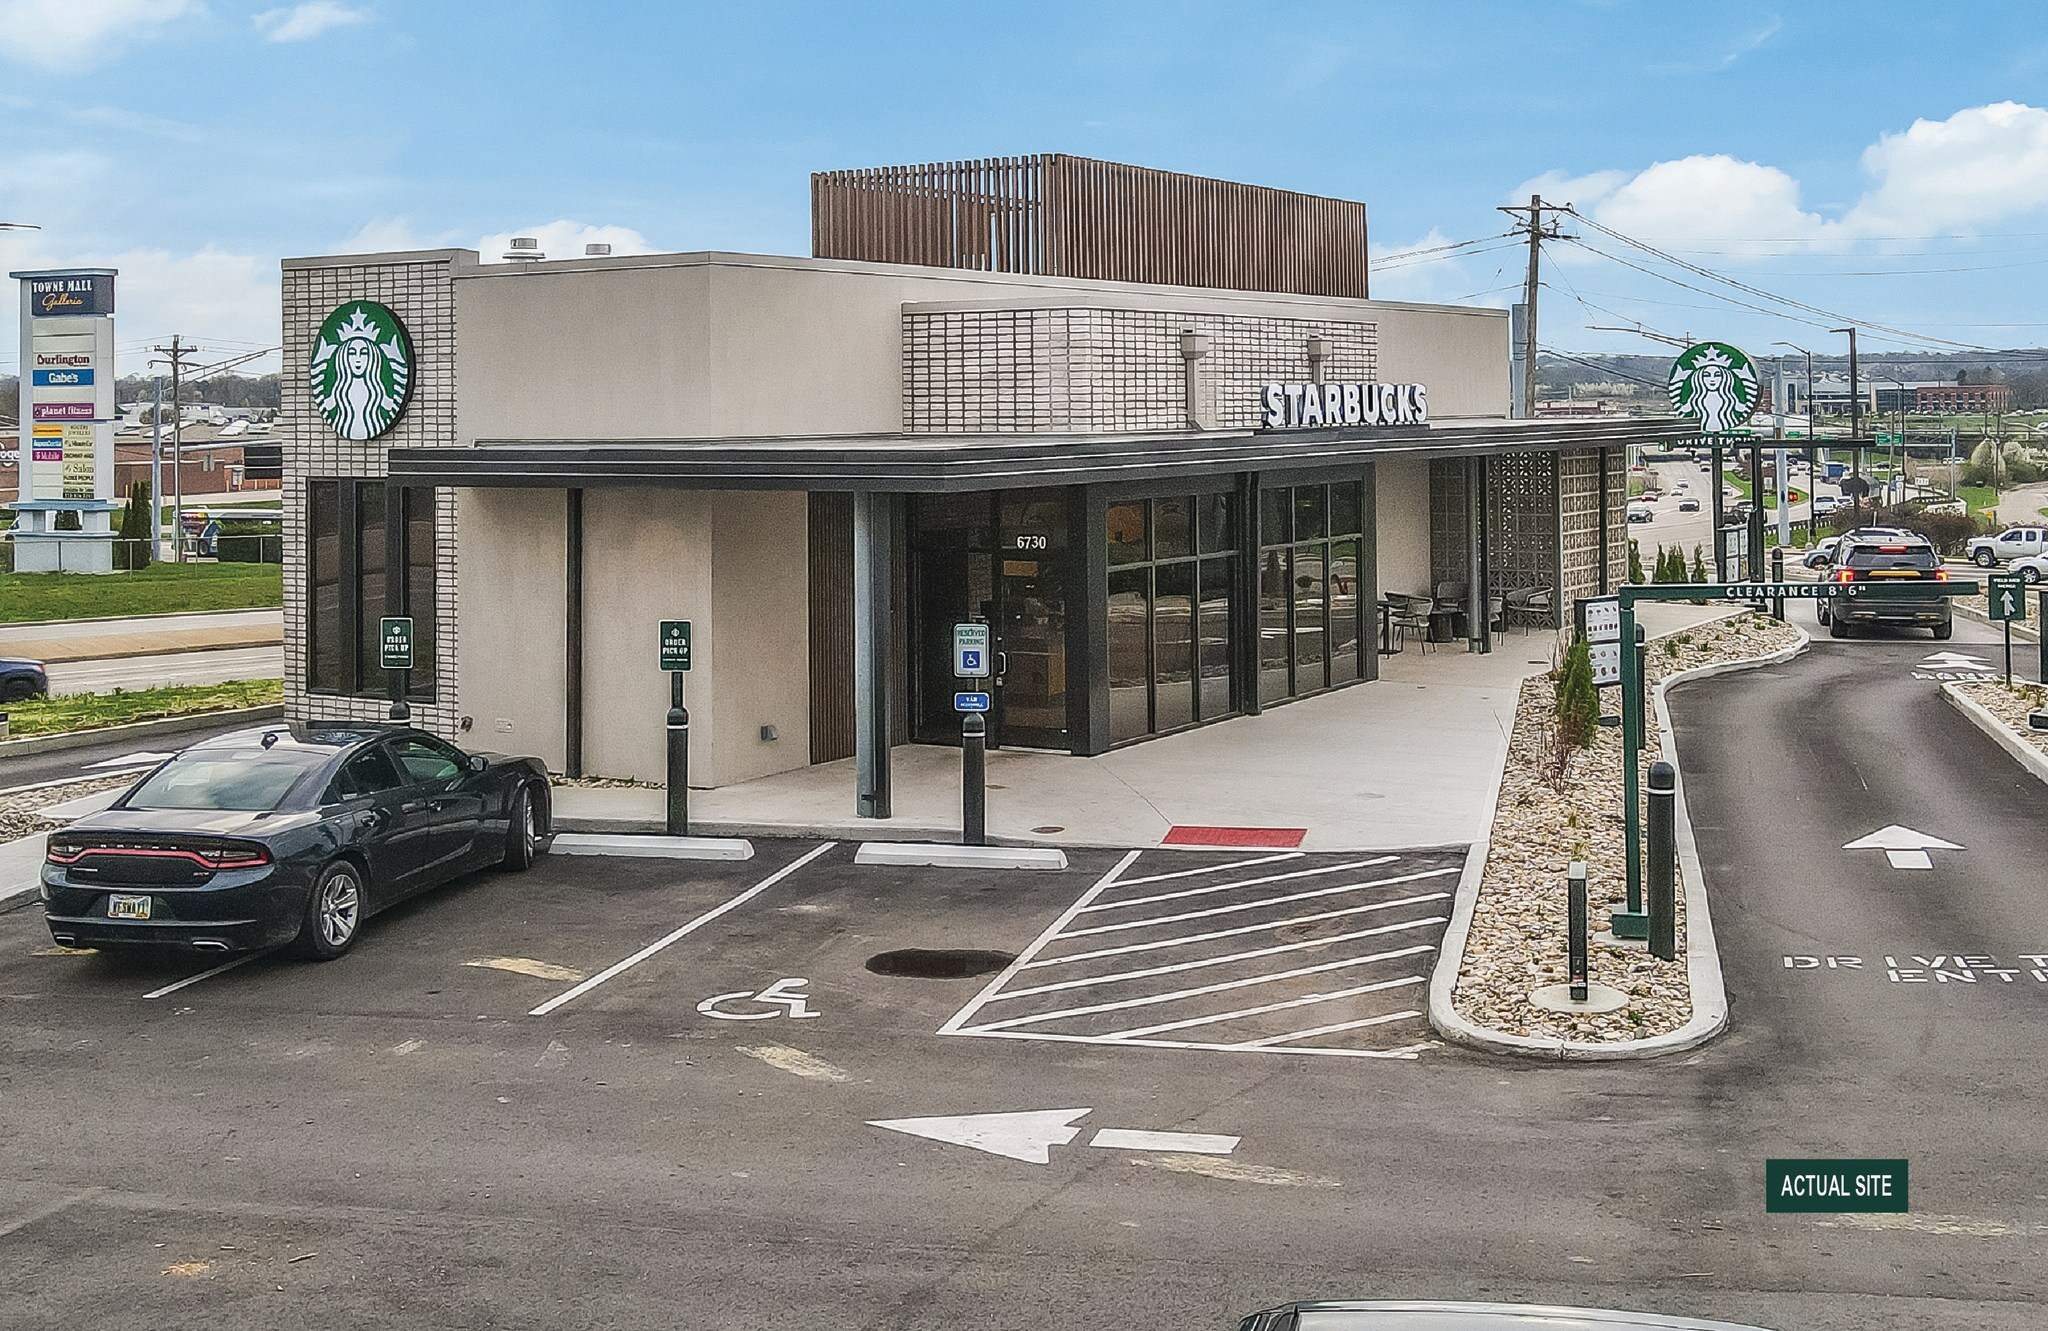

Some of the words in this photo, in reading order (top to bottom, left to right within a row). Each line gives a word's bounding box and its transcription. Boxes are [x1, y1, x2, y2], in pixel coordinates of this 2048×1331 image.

[33, 281, 64, 292] TOWNE
[67, 280, 92, 291] MALL
[49, 372, 79, 383] Gabe's
[41, 405, 66, 417] planet
[1262, 382, 1428, 428] STARBUCKS
[1017, 535, 1047, 549] 6730
[1726, 586, 1819, 597] CLEARANCE
[957, 629, 985, 637] RESERVED
